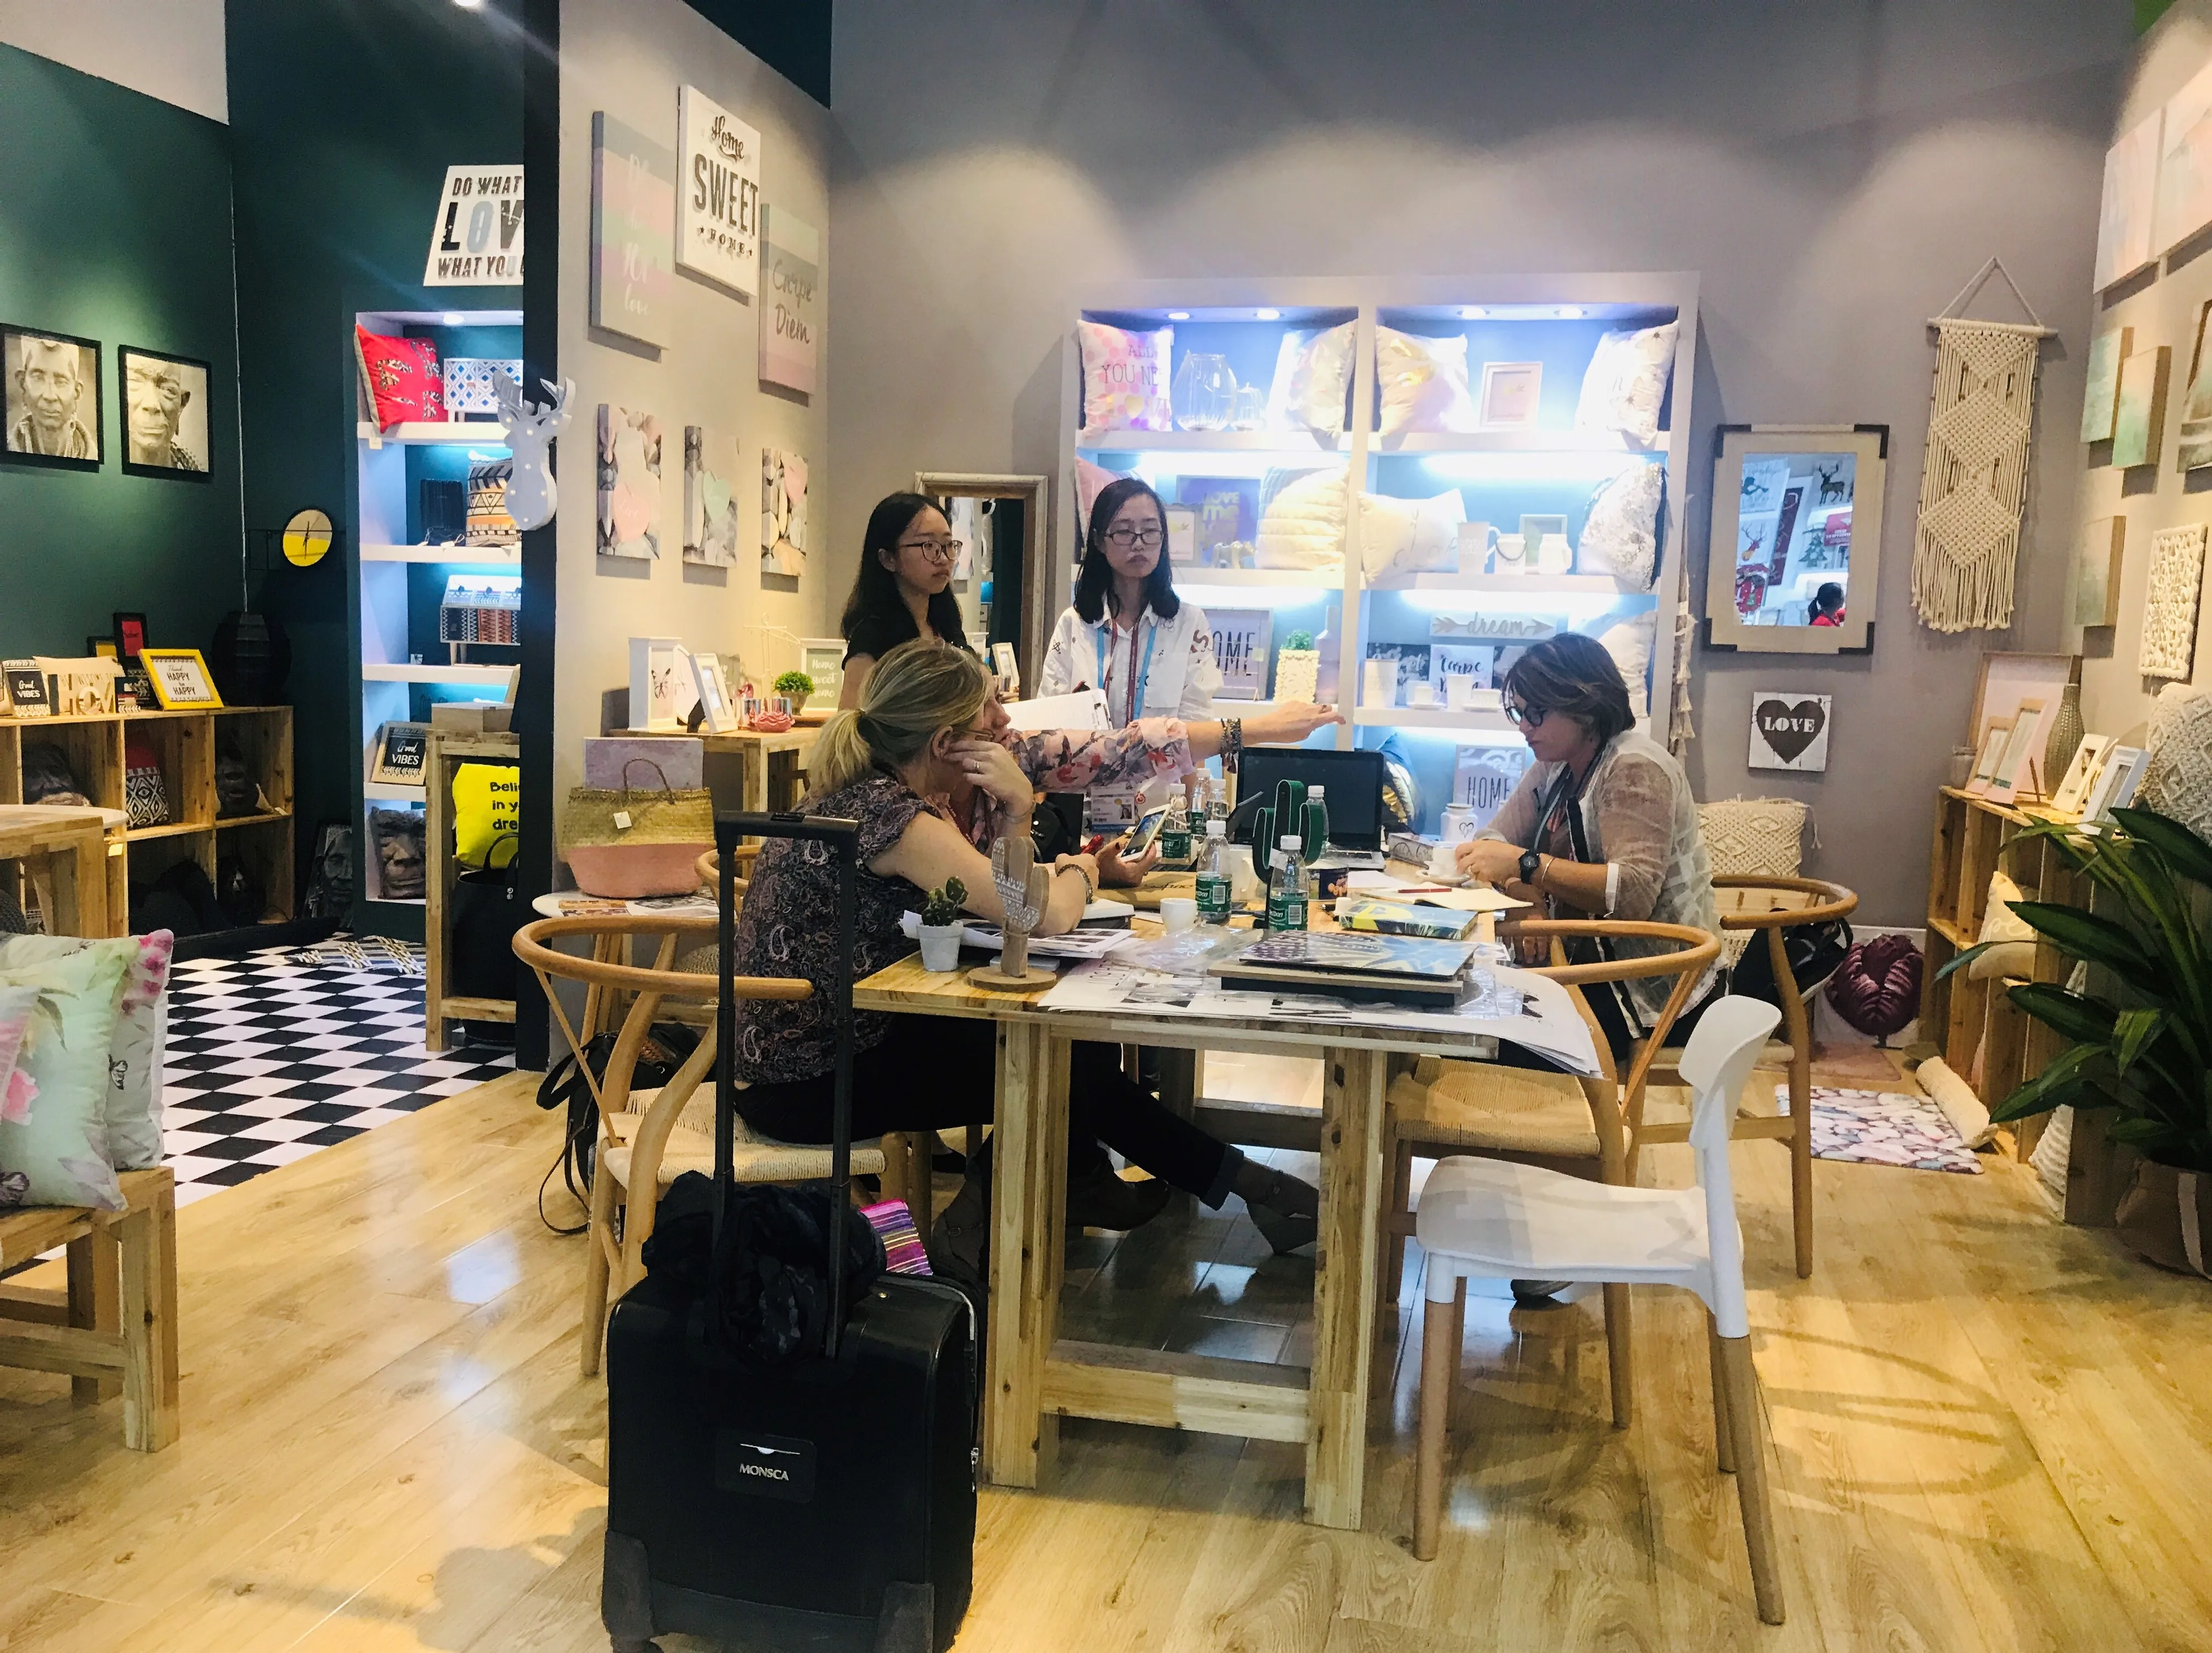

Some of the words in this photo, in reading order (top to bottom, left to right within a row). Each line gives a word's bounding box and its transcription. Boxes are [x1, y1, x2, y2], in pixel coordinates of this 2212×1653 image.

[712, 116, 744, 161] Home
[452, 177, 472, 196] DO
[477, 176, 522, 195] WHAT
[694, 154, 758, 236] SWEET
[710, 228, 746, 254] HOME
[438, 257, 482, 279] WHAT
[487, 256, 517, 277] YOU
[773, 259, 812, 310] Carpe
[775, 303, 810, 345] Diem
[1129, 345, 1154, 358] ALL
[1101, 364, 1141, 384] YOU
[1141, 366, 1164, 386] NE
[1466, 611, 1527, 636] dream
[812, 659, 836, 670] Home
[16, 690, 41, 698] VIBES
[19, 680, 35, 690] Good
[1764, 717, 1815, 732] LOVE
[397, 740, 419, 753] Good
[392, 753, 419, 765] VIBES
[489, 782, 520, 792] Beli
[492, 800, 505, 810] in
[509, 802, 520, 812] y
[739, 1463, 789, 1481] MONSCA
